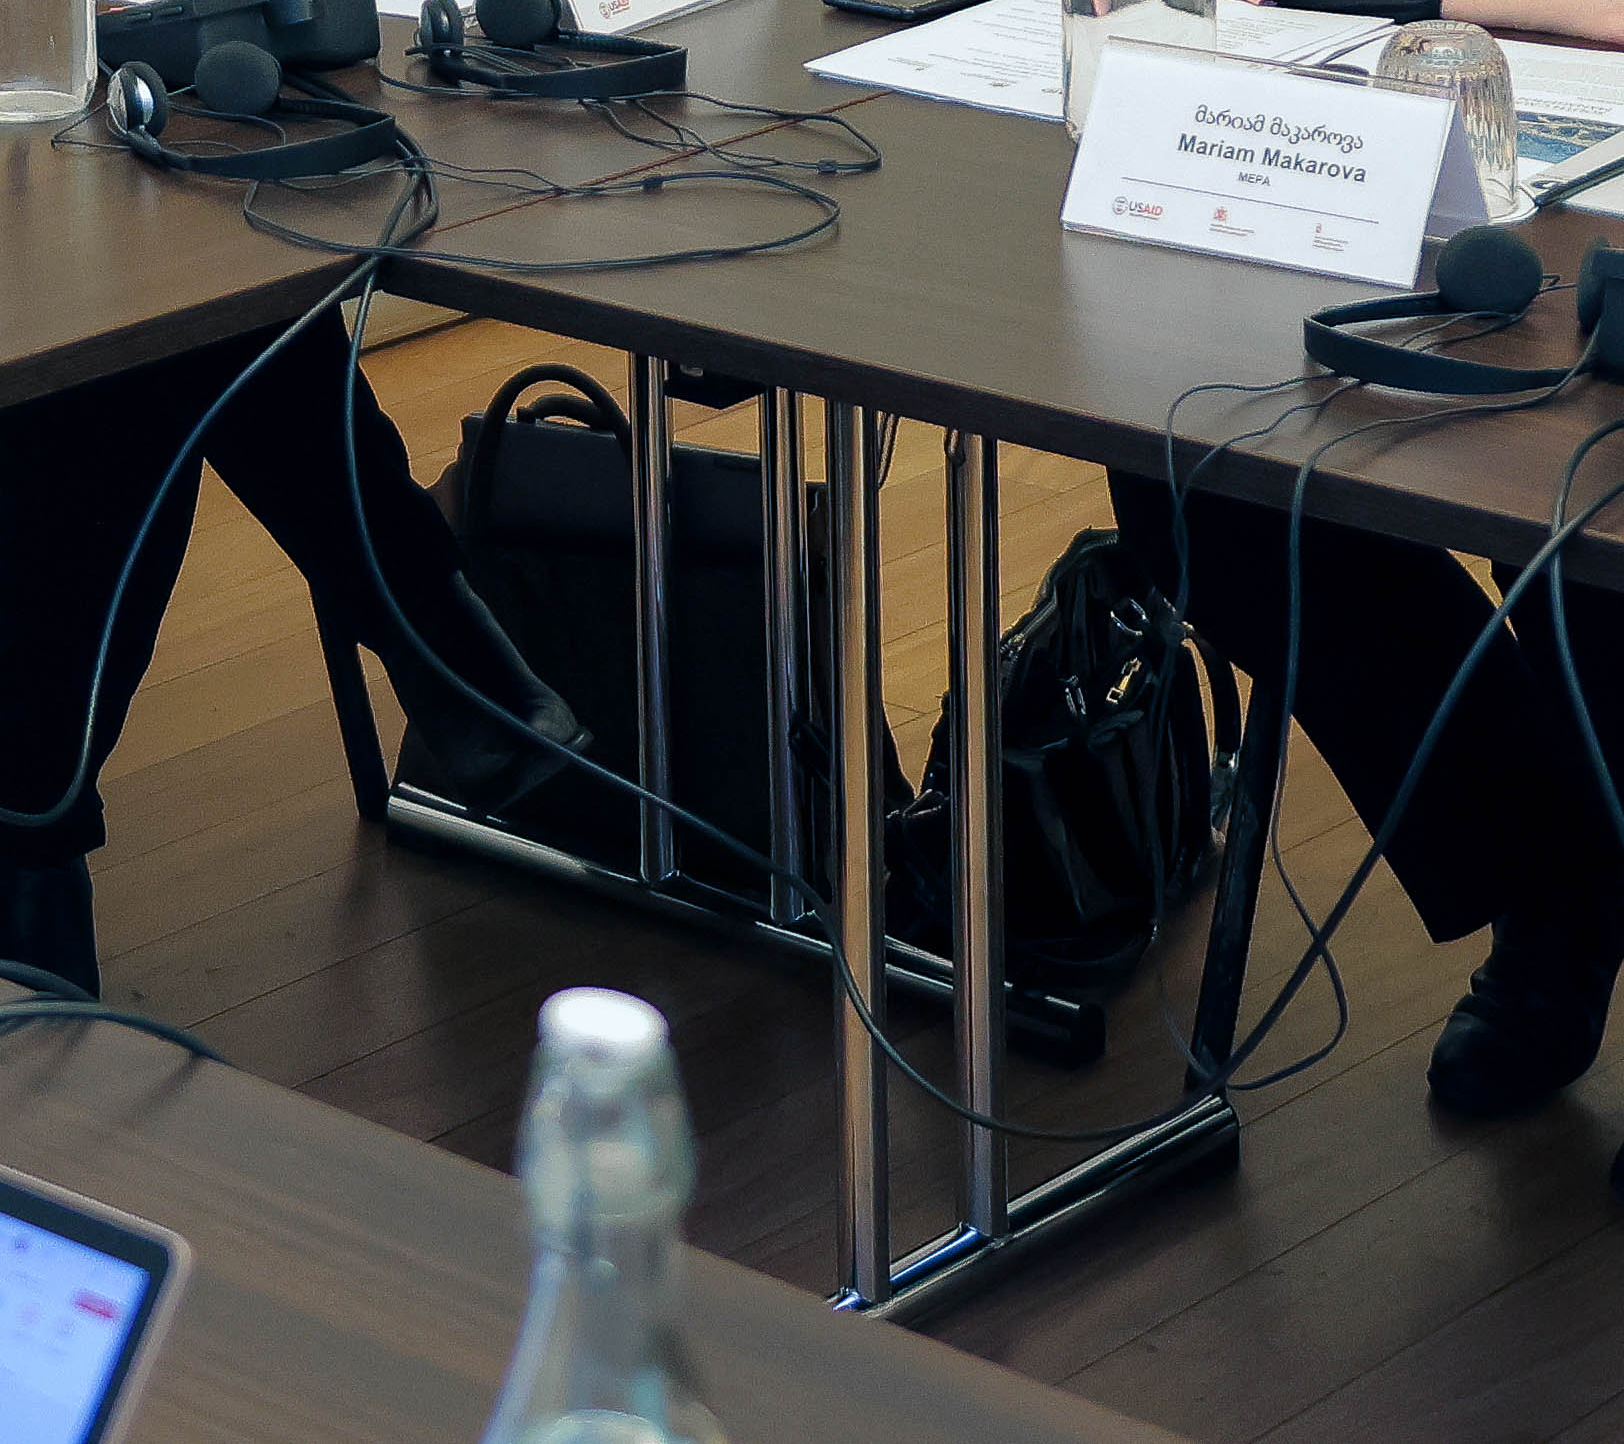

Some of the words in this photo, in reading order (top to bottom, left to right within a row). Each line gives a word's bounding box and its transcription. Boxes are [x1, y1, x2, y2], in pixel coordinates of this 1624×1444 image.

[1195, 104, 1266, 132] მარიამ
[1270, 116, 1364, 153] მაკაროვა
[1177, 133, 1255, 163] Mariam
[1262, 147, 1367, 183] Makarova
[1238, 171, 1271, 187] MEPA
[1128, 200, 1163, 216] USAID
